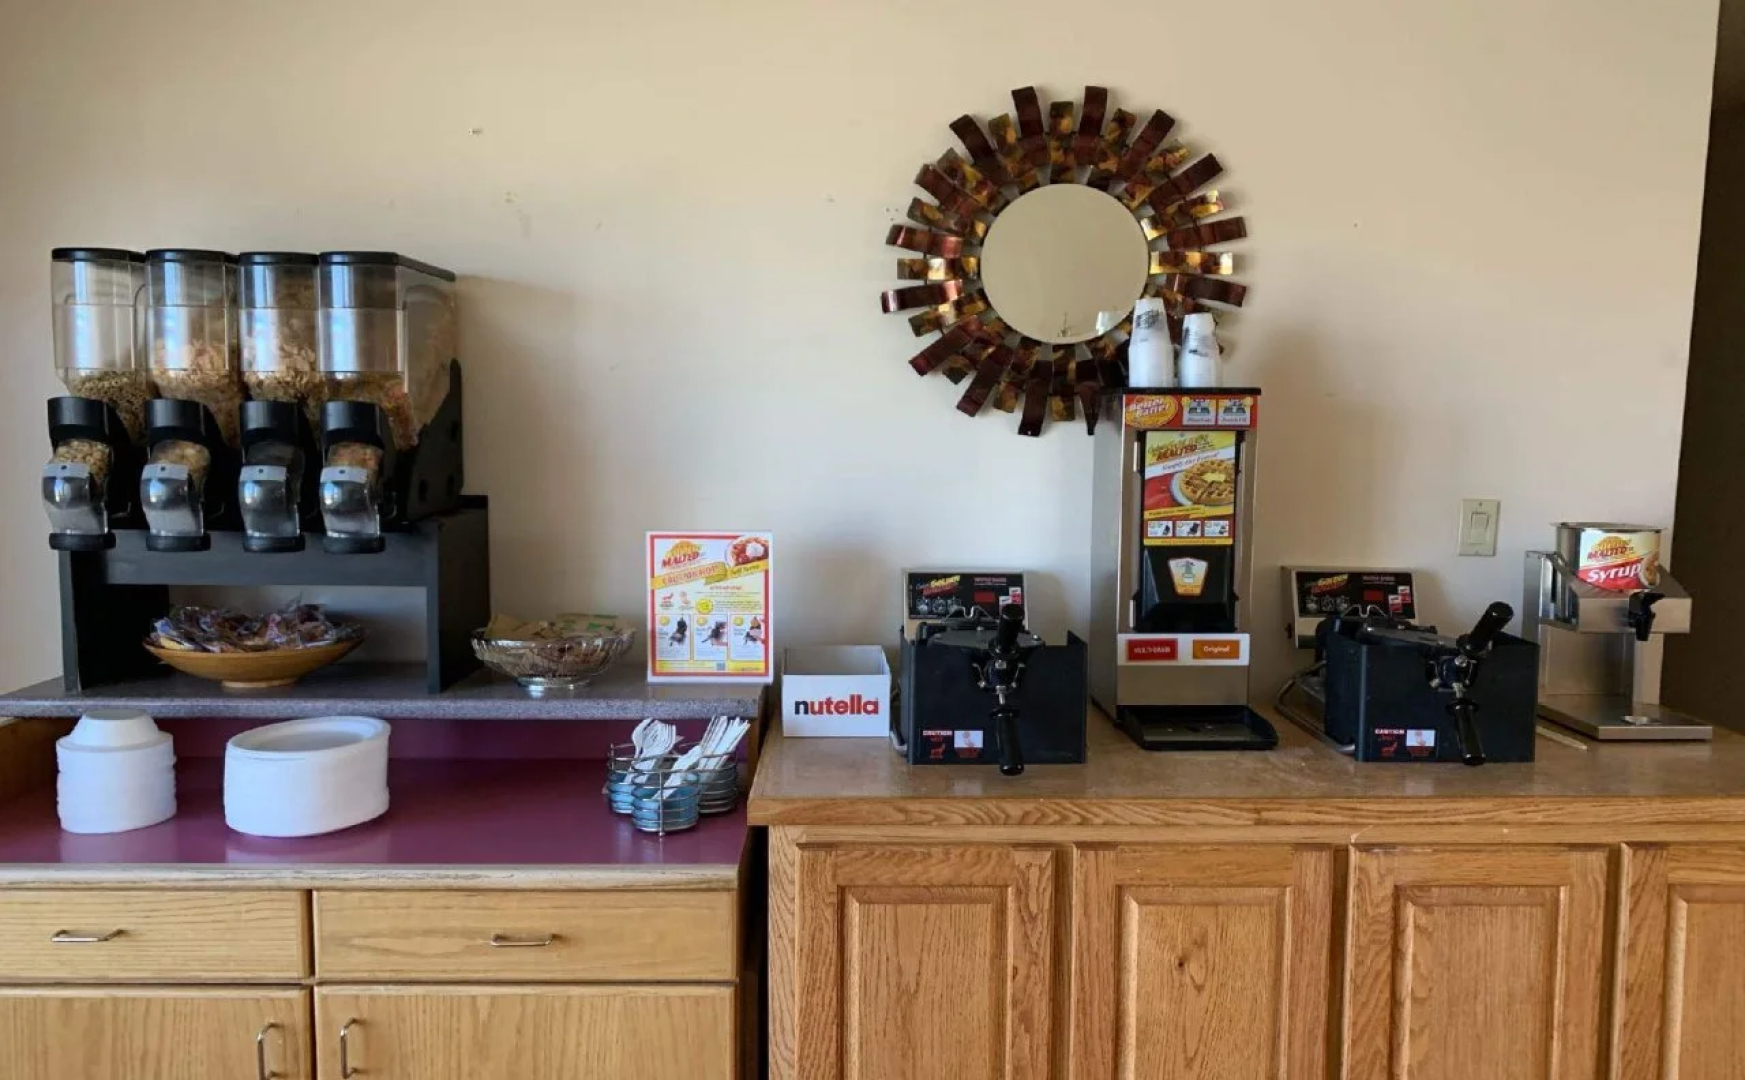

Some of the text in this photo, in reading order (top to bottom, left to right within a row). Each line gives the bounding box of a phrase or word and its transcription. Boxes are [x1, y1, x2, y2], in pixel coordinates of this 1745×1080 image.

[1586, 563, 1642, 583] Syrup
[1203, 645, 1231, 653] Original
[794, 694, 879, 715] nutella
